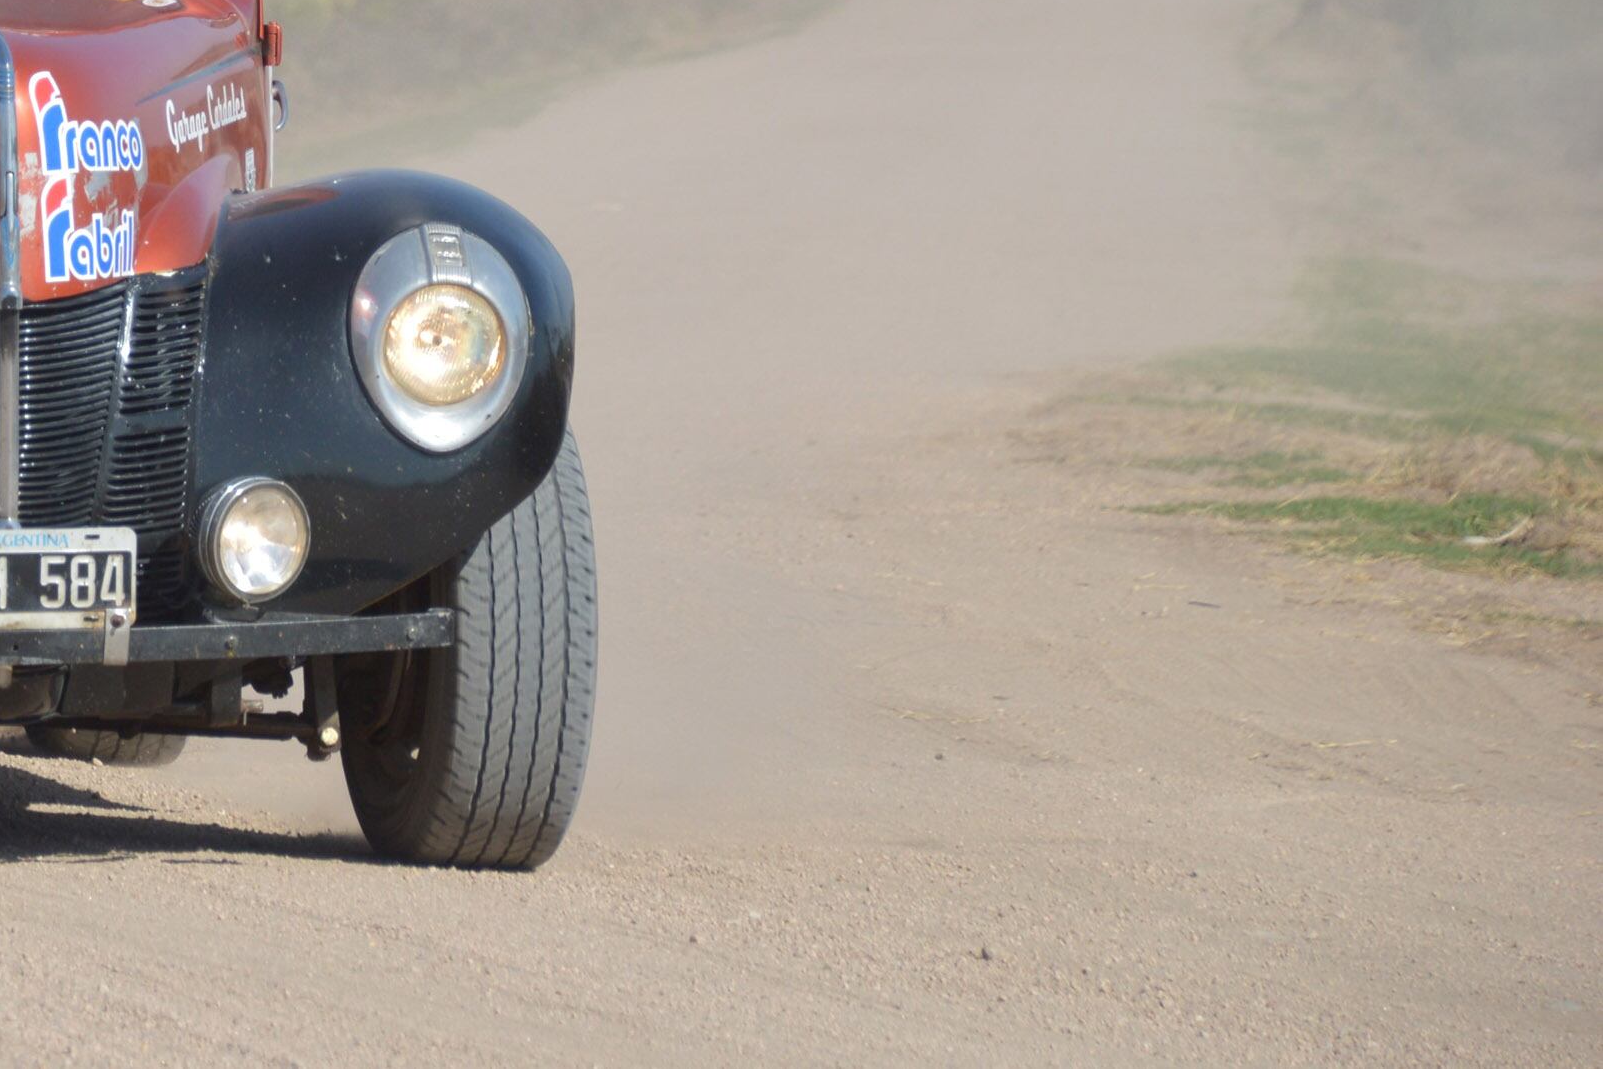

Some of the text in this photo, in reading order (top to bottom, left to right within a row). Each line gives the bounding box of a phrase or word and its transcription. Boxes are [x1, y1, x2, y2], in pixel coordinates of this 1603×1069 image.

[165, 82, 247, 153] Garage Cardales
[39, 554, 126, 609] 584
